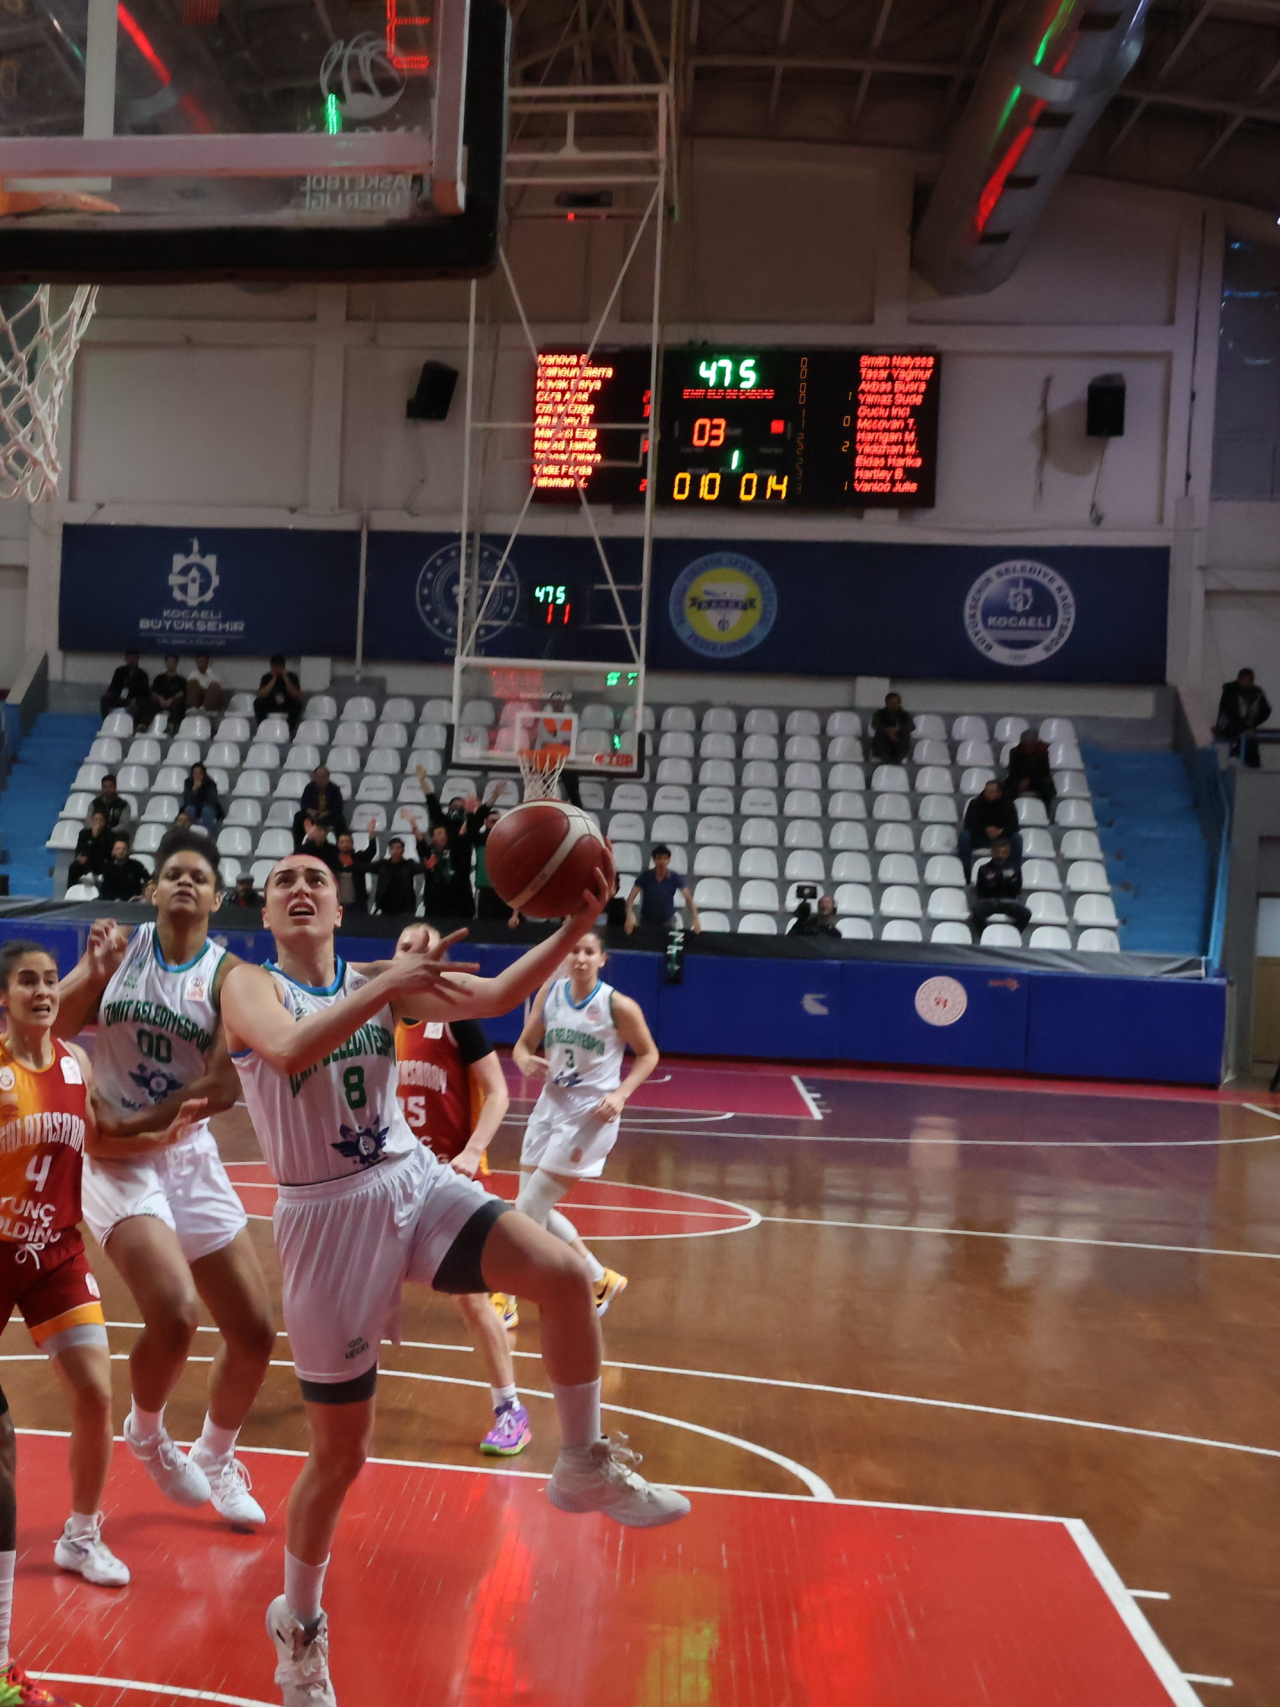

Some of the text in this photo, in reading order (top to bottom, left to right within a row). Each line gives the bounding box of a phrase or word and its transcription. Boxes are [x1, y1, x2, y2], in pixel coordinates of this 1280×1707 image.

[136, 1028, 173, 1064] 00
[342, 1065, 368, 1111] 8
[25, 1155, 53, 1193] 4
